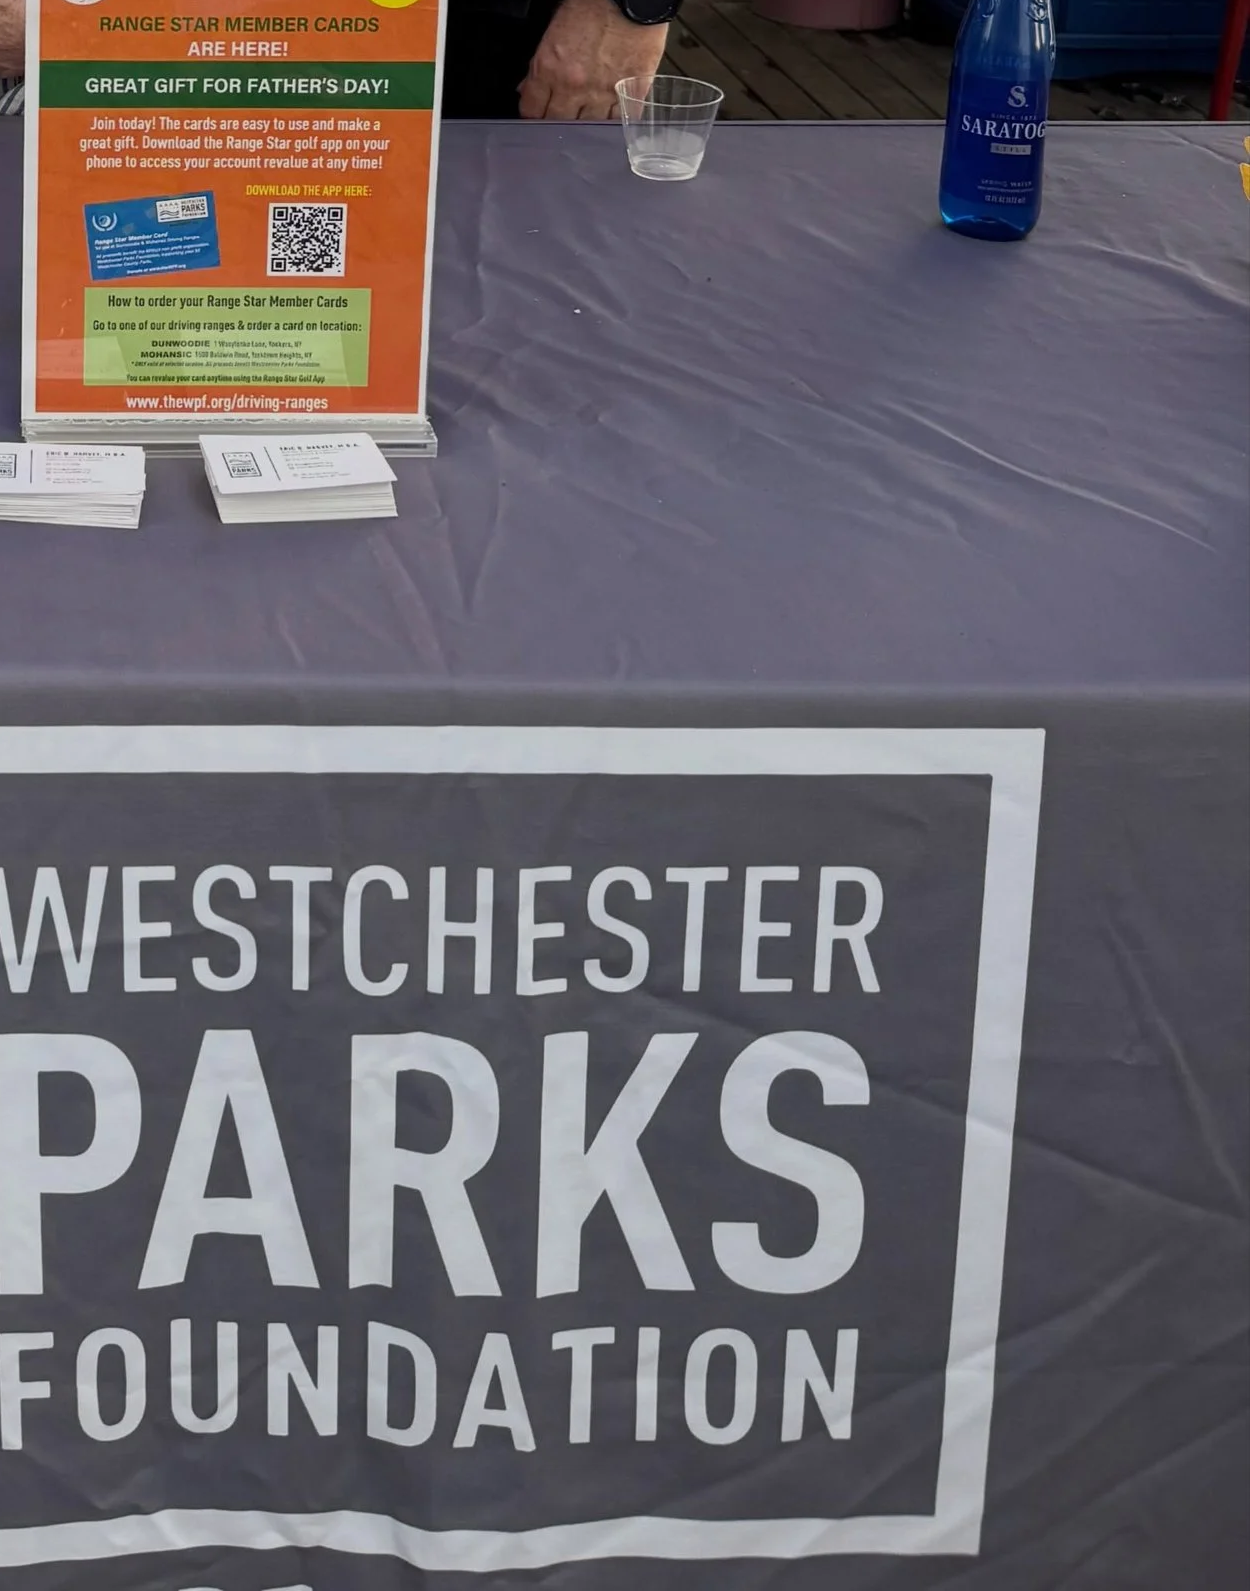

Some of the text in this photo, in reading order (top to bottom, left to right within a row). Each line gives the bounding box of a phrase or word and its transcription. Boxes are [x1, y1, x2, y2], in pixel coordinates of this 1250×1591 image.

[100, 17, 379, 32] RANGE STAR MEMBER CARDS
[188, 41, 288, 56] ARE HERE!
[85, 78, 389, 94] GREAT GIFT FOR FATHER'S DAY!
[1007, 86, 1029, 107] S.
[90, 117, 380, 133] Join today! The cards are easy to use and make a
[80, 136, 390, 152] great gift. Download the Range Star golf app on your
[86, 156, 382, 171] phone to access your account revalue at any time!
[246, 185, 372, 196] DOWNLOAD THE APP HERE:
[181, 203, 205, 212] PARKS
[108, 295, 348, 309] How to order your Range Star Member Cards
[93, 320, 104, 330] Go
[107, 321, 116, 330] to
[120, 322, 136, 330] one
[139, 320, 148, 330] of
[150, 322, 165, 330] our
[169, 320, 200, 332] driving
[203, 322, 234, 332] ranges
[238, 321, 245, 330] &
[247, 321, 272, 330] order
[282, 321, 303, 330] card
[306, 323, 317, 331] on
[320, 321, 362, 331] location:
[207, 375, 232, 383] anytime
[233, 375, 250, 383] using
[263, 375, 283, 383] Range
[313, 376, 325, 384] App
[126, 393, 328, 412] www.thewpf.org/driving-ranges
[0, 1318, 858, 1453] FOUNDATION
